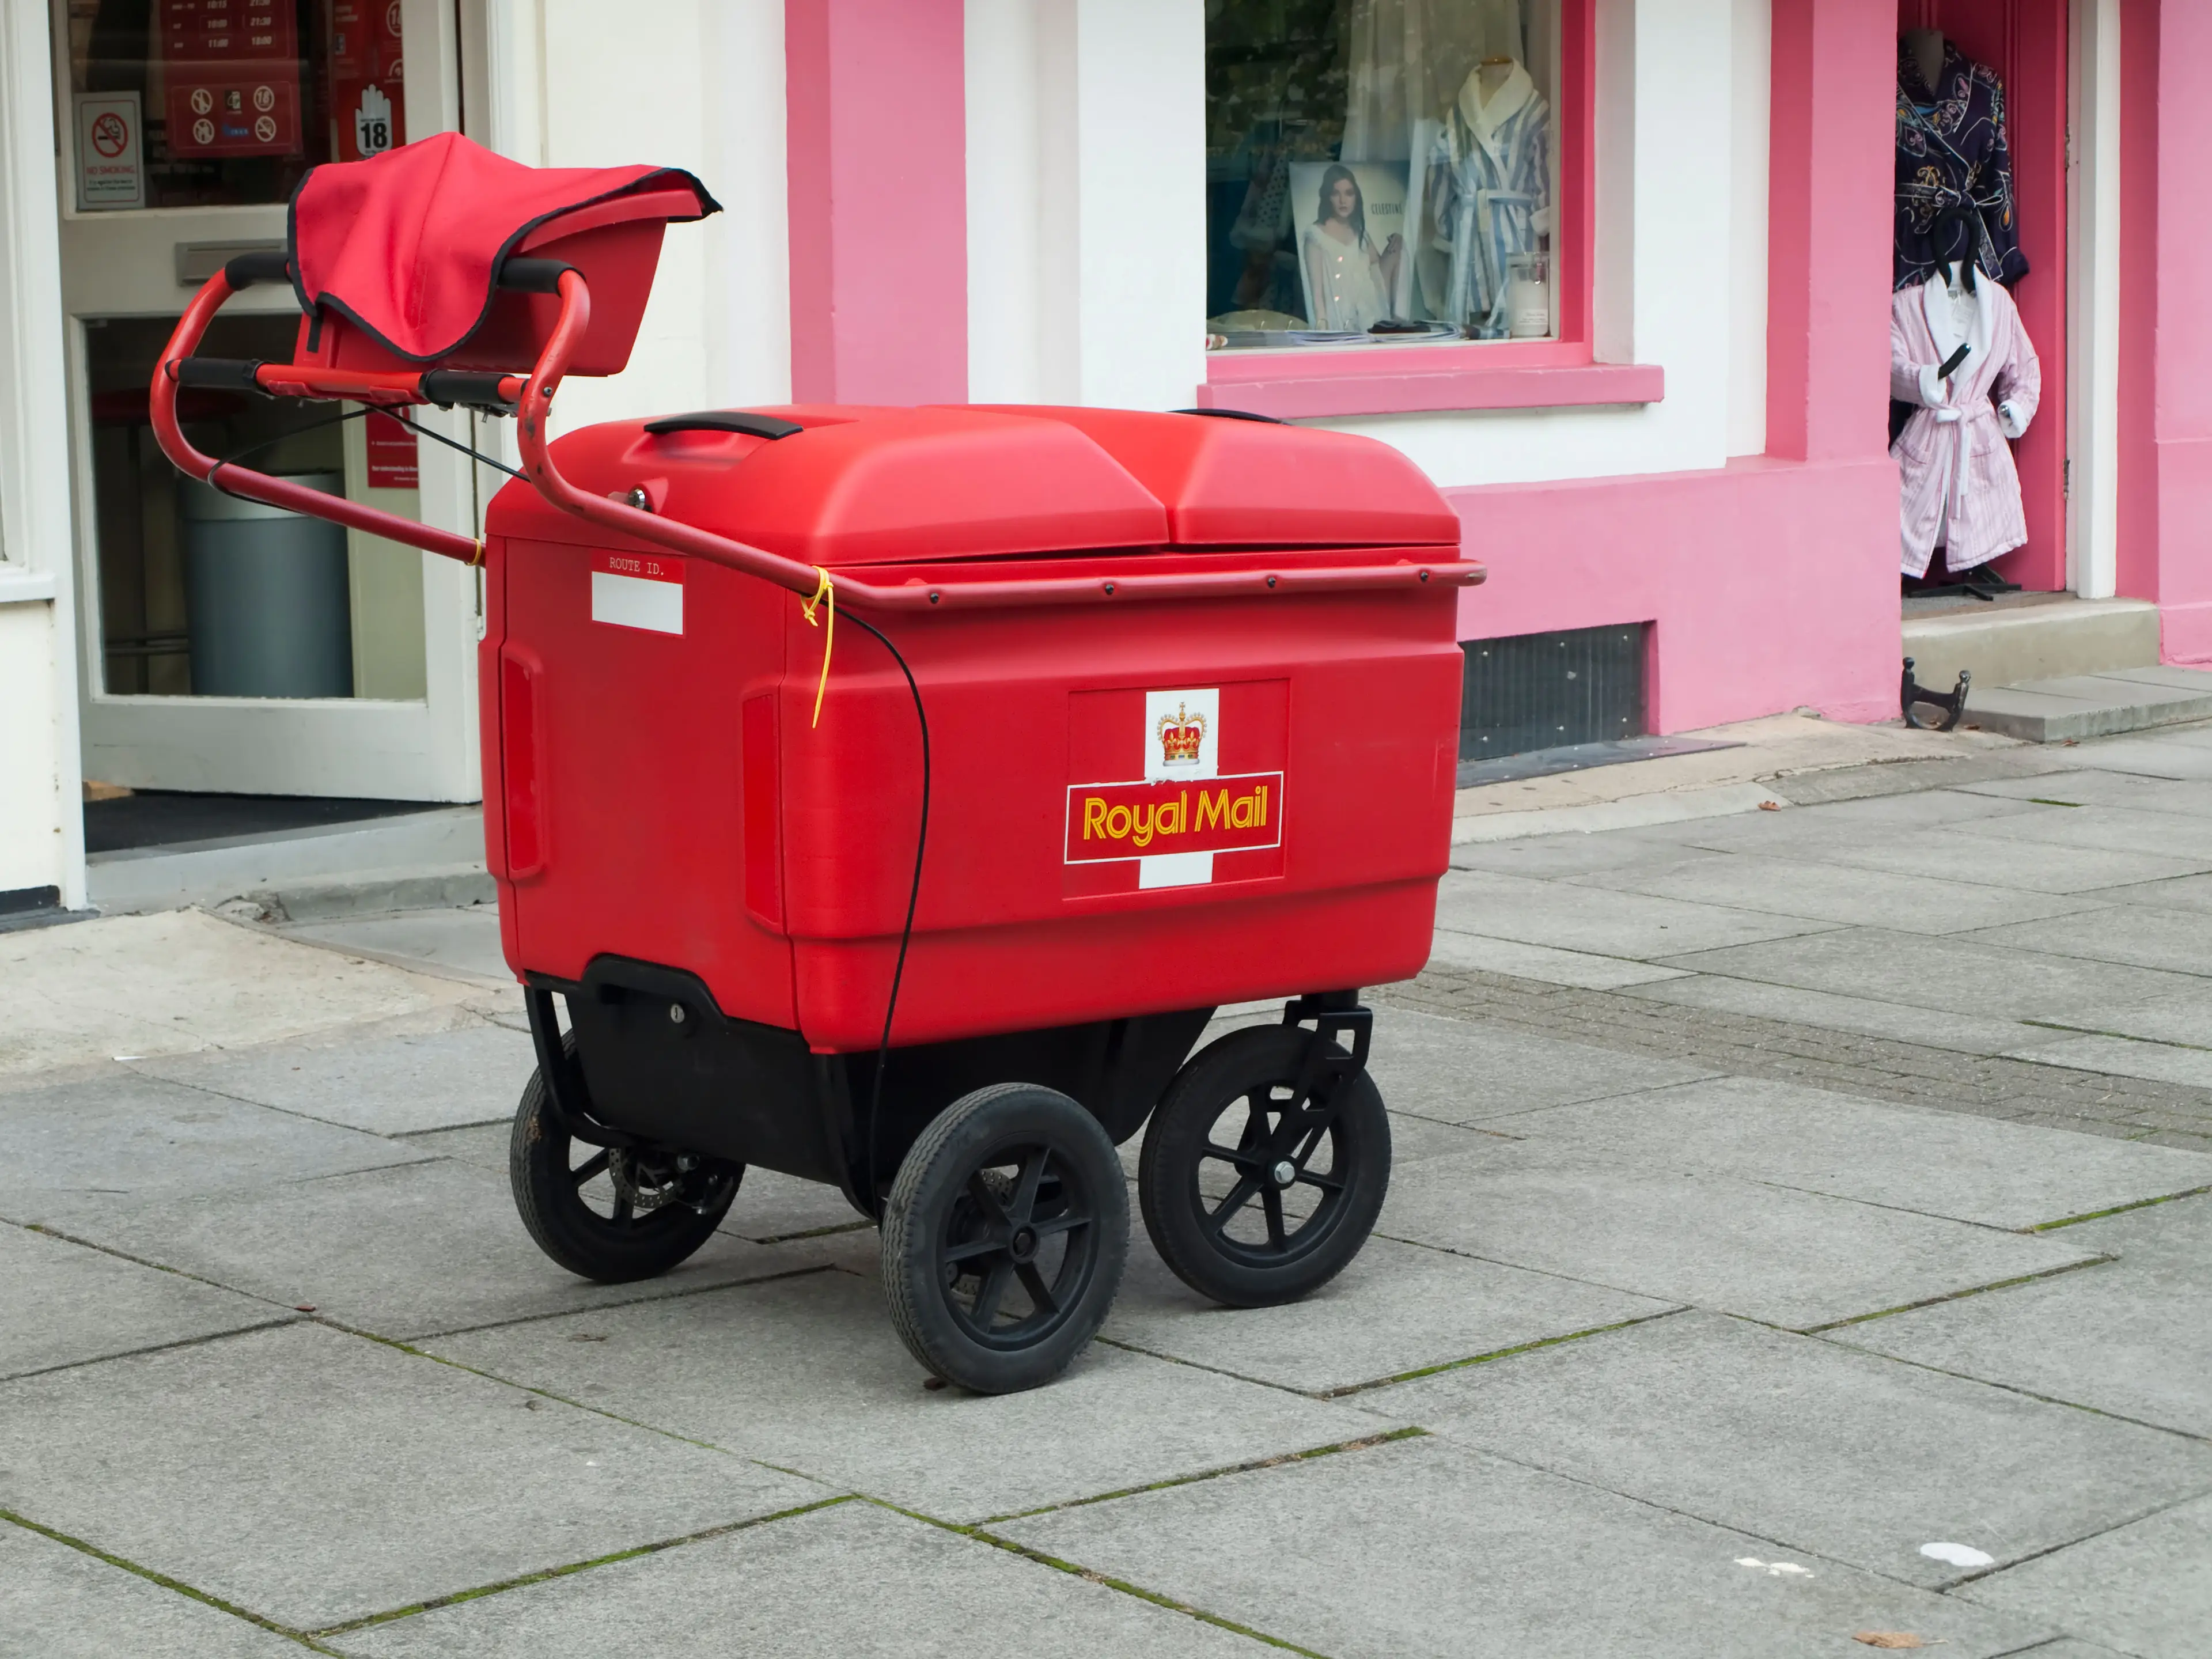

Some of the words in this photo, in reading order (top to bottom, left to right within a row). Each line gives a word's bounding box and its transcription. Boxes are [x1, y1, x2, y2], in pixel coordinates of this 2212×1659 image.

[258, 90, 270, 104] 18
[361, 123, 388, 148] 18
[86, 166, 98, 175] NO
[99, 165, 135, 175] SMOKING
[609, 557, 641, 572] ROUTE
[647, 562, 664, 575] ID.
[1083, 790, 1187, 847] Royal
[1194, 785, 1268, 832] Mail
